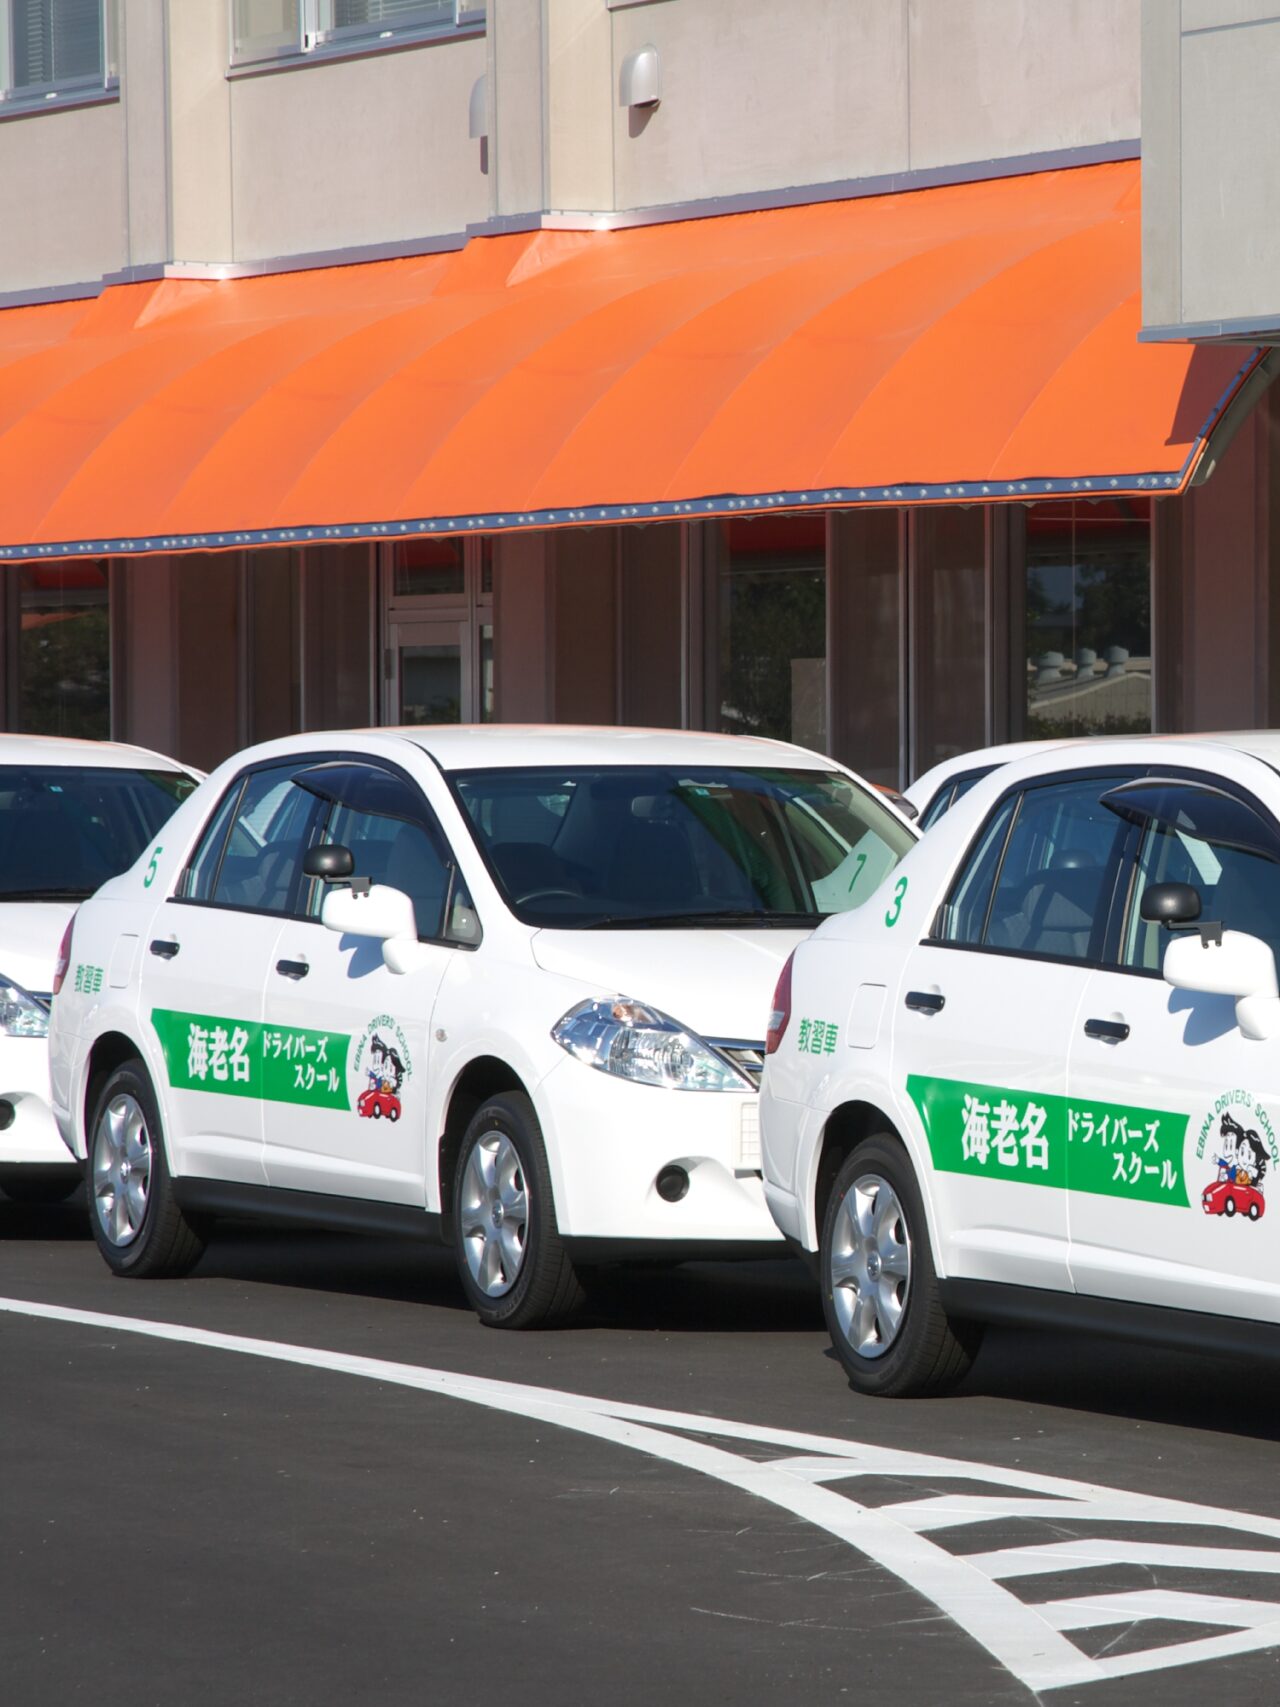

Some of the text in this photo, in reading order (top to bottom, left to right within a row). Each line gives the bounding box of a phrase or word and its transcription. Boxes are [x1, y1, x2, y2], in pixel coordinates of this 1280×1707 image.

[144, 847, 163, 888] 5
[848, 853, 867, 893] 7
[885, 876, 908, 928] 3
[74, 964, 104, 994] 教習車
[187, 1022, 250, 1083] 海老名
[262, 1030, 329, 1064] ドライバーズ
[798, 1016, 839, 1056] 教習車
[294, 1063, 340, 1093] スクール
[961, 1093, 1049, 1170] 海老名
[1067, 1108, 1161, 1153] ドライバーズ
[1195, 1112, 1215, 1160] EBINA
[1254, 1103, 1280, 1171] SCHOOL
[1112, 1151, 1178, 1190] スクール
